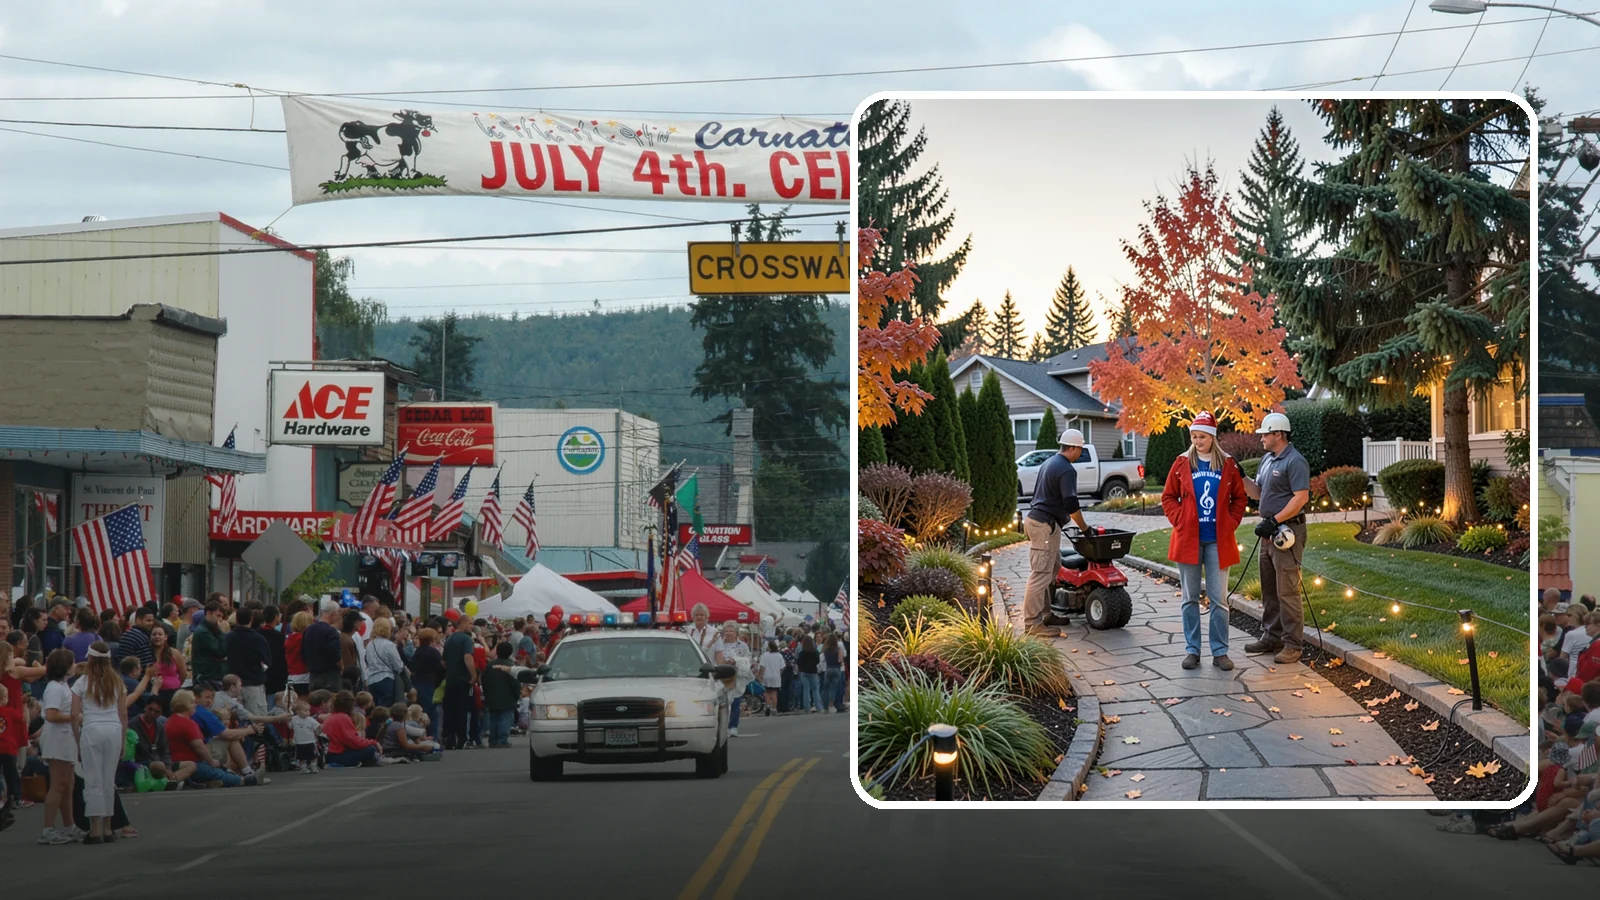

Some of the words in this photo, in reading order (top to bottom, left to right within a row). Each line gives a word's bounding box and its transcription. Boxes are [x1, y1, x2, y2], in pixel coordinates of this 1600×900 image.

[695, 121, 850, 150] Carnat
[481, 141, 605, 192] JULY
[632, 150, 746, 198] 4th.
[697, 254, 850, 280] CROSSWA
[283, 380, 373, 420] ACE
[405, 409, 453, 422] CEDAR
[283, 421, 371, 436] Hardware
[353, 466, 387, 480] Simpl
[95, 485, 124, 494] Vincent
[126, 486, 136, 494] de
[137, 486, 155, 495] Paul
[688, 526, 741, 535] CRNATION
[699, 535, 730, 543] GLASS
